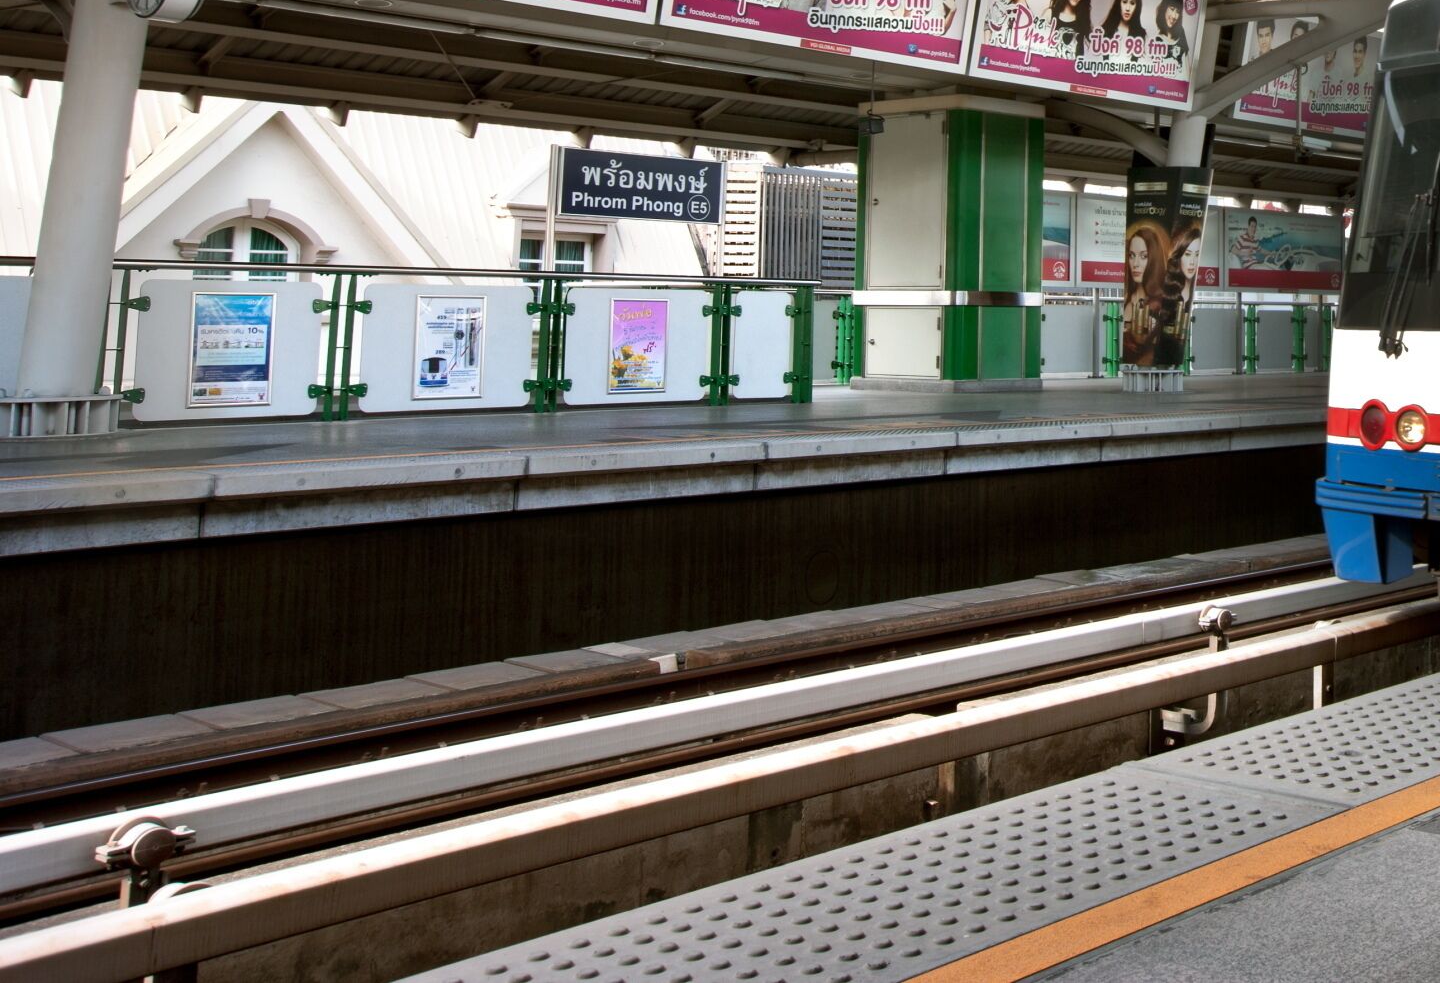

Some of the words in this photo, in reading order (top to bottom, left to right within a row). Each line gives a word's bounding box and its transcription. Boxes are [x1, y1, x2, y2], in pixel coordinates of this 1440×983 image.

[1126, 39, 1143, 55] 98
[1148, 39, 1167, 56] fm
[1347, 82, 1360, 95] 98
[581, 159, 709, 194] พร้อมพงษ์
[571, 192, 627, 210] Phrom
[631, 196, 683, 217] Phong
[690, 201, 708, 214] E5
